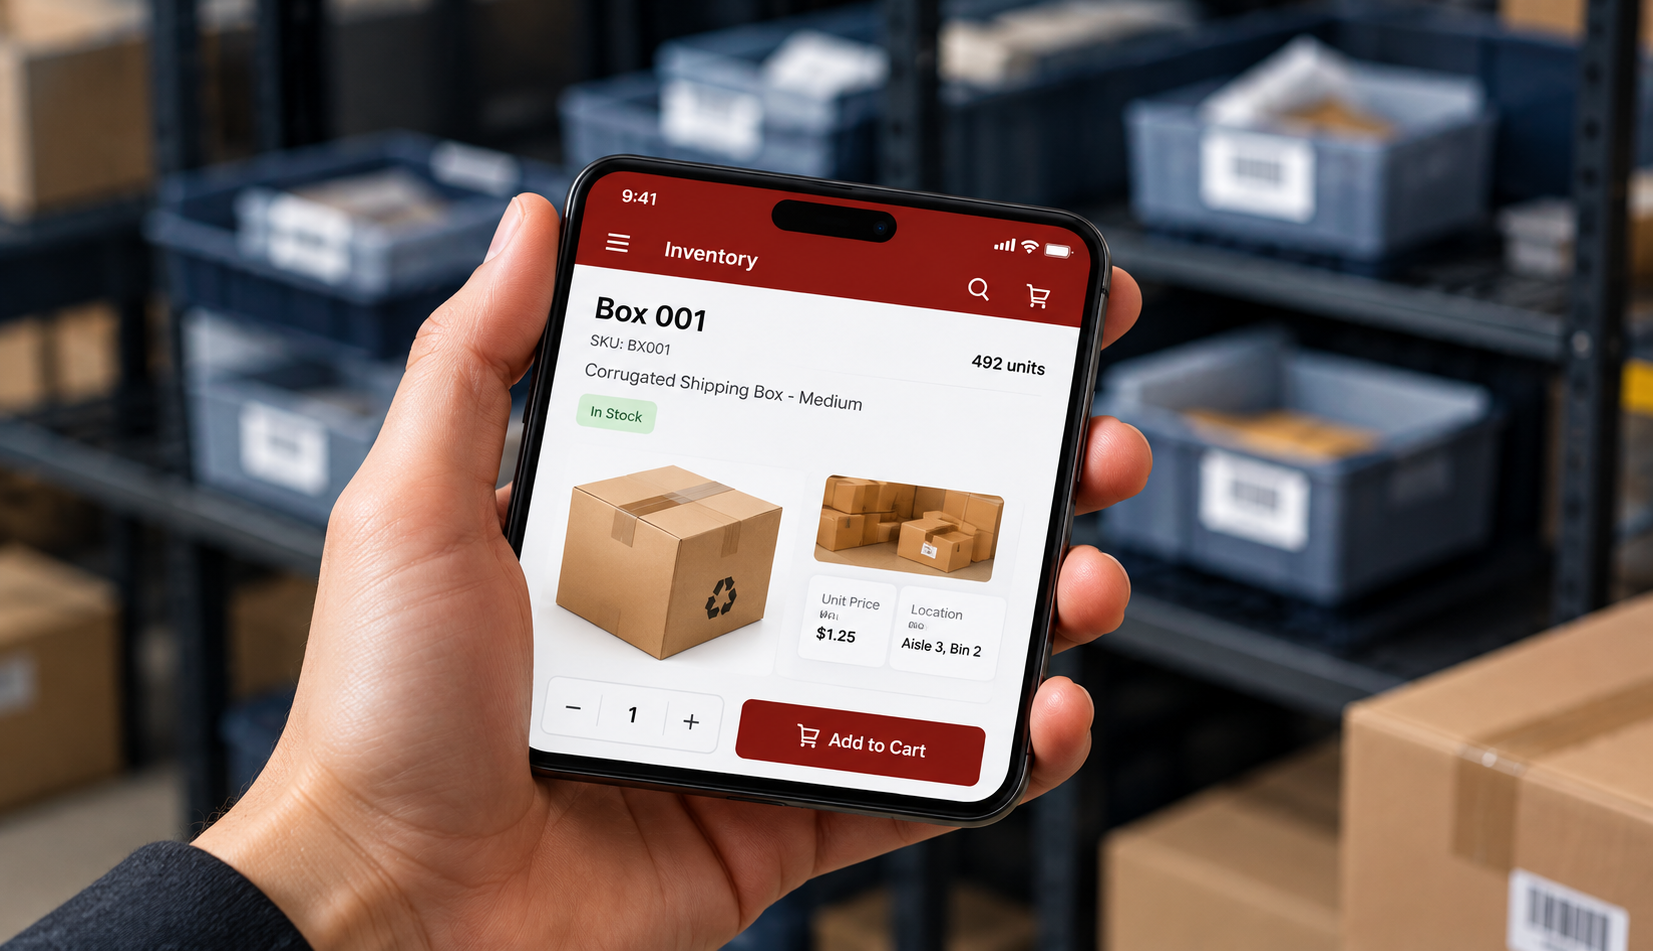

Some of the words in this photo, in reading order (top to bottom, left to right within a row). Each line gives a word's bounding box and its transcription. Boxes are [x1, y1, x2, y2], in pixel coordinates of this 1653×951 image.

[621, 189, 657, 206] 9:41
[664, 241, 759, 271] Inventory
[595, 296, 649, 325] Box
[655, 304, 706, 332] 001
[590, 334, 624, 350] SKU:
[627, 339, 671, 355] BX001
[971, 354, 1003, 371] 492
[1007, 359, 1046, 376] units
[584, 362, 676, 388] Corrugated
[680, 375, 750, 400] Shipping
[753, 384, 783, 401] Box
[799, 390, 863, 411] Medium
[590, 406, 602, 418] In
[605, 407, 643, 423] Stock
[821, 593, 847, 607] Unit
[849, 596, 881, 611] Price
[911, 604, 964, 620] Location
[816, 626, 856, 644] $1.25
[901, 637, 932, 652] Aisle
[935, 641, 946, 655] 3,
[950, 643, 970, 656] Bin
[973, 646, 982, 657] 2
[628, 706, 638, 724] 1
[828, 732, 864, 753] Add
[867, 737, 886, 754] to
[888, 740, 927, 759] Cart
